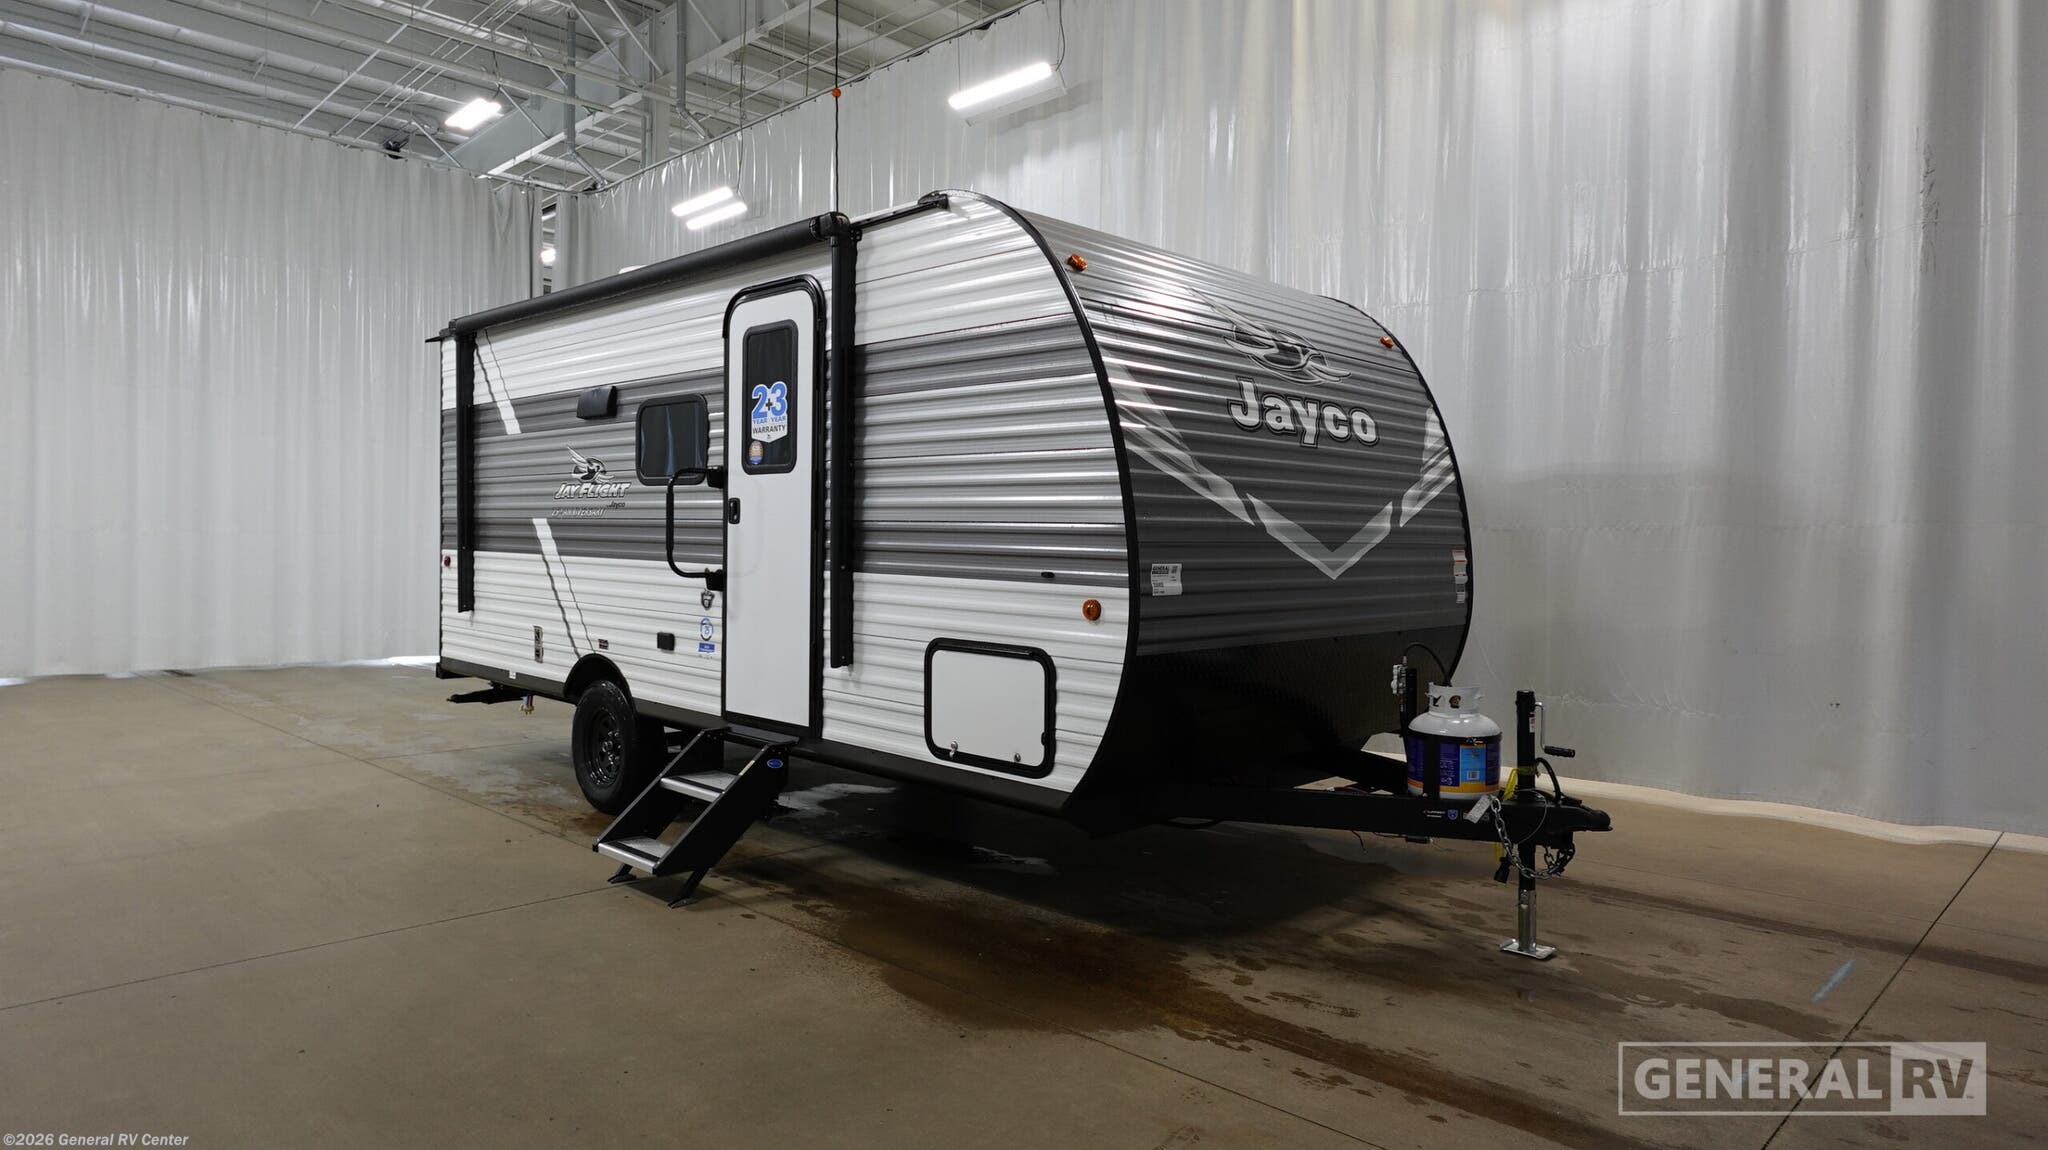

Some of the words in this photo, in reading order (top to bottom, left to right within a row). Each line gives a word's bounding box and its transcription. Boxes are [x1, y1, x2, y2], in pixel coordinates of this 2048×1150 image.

[1228, 376, 1380, 448] Jayco
[752, 425, 786, 434] WARRANTY
[554, 483, 580, 499] JAY
[579, 482, 631, 498] FLIGHT
